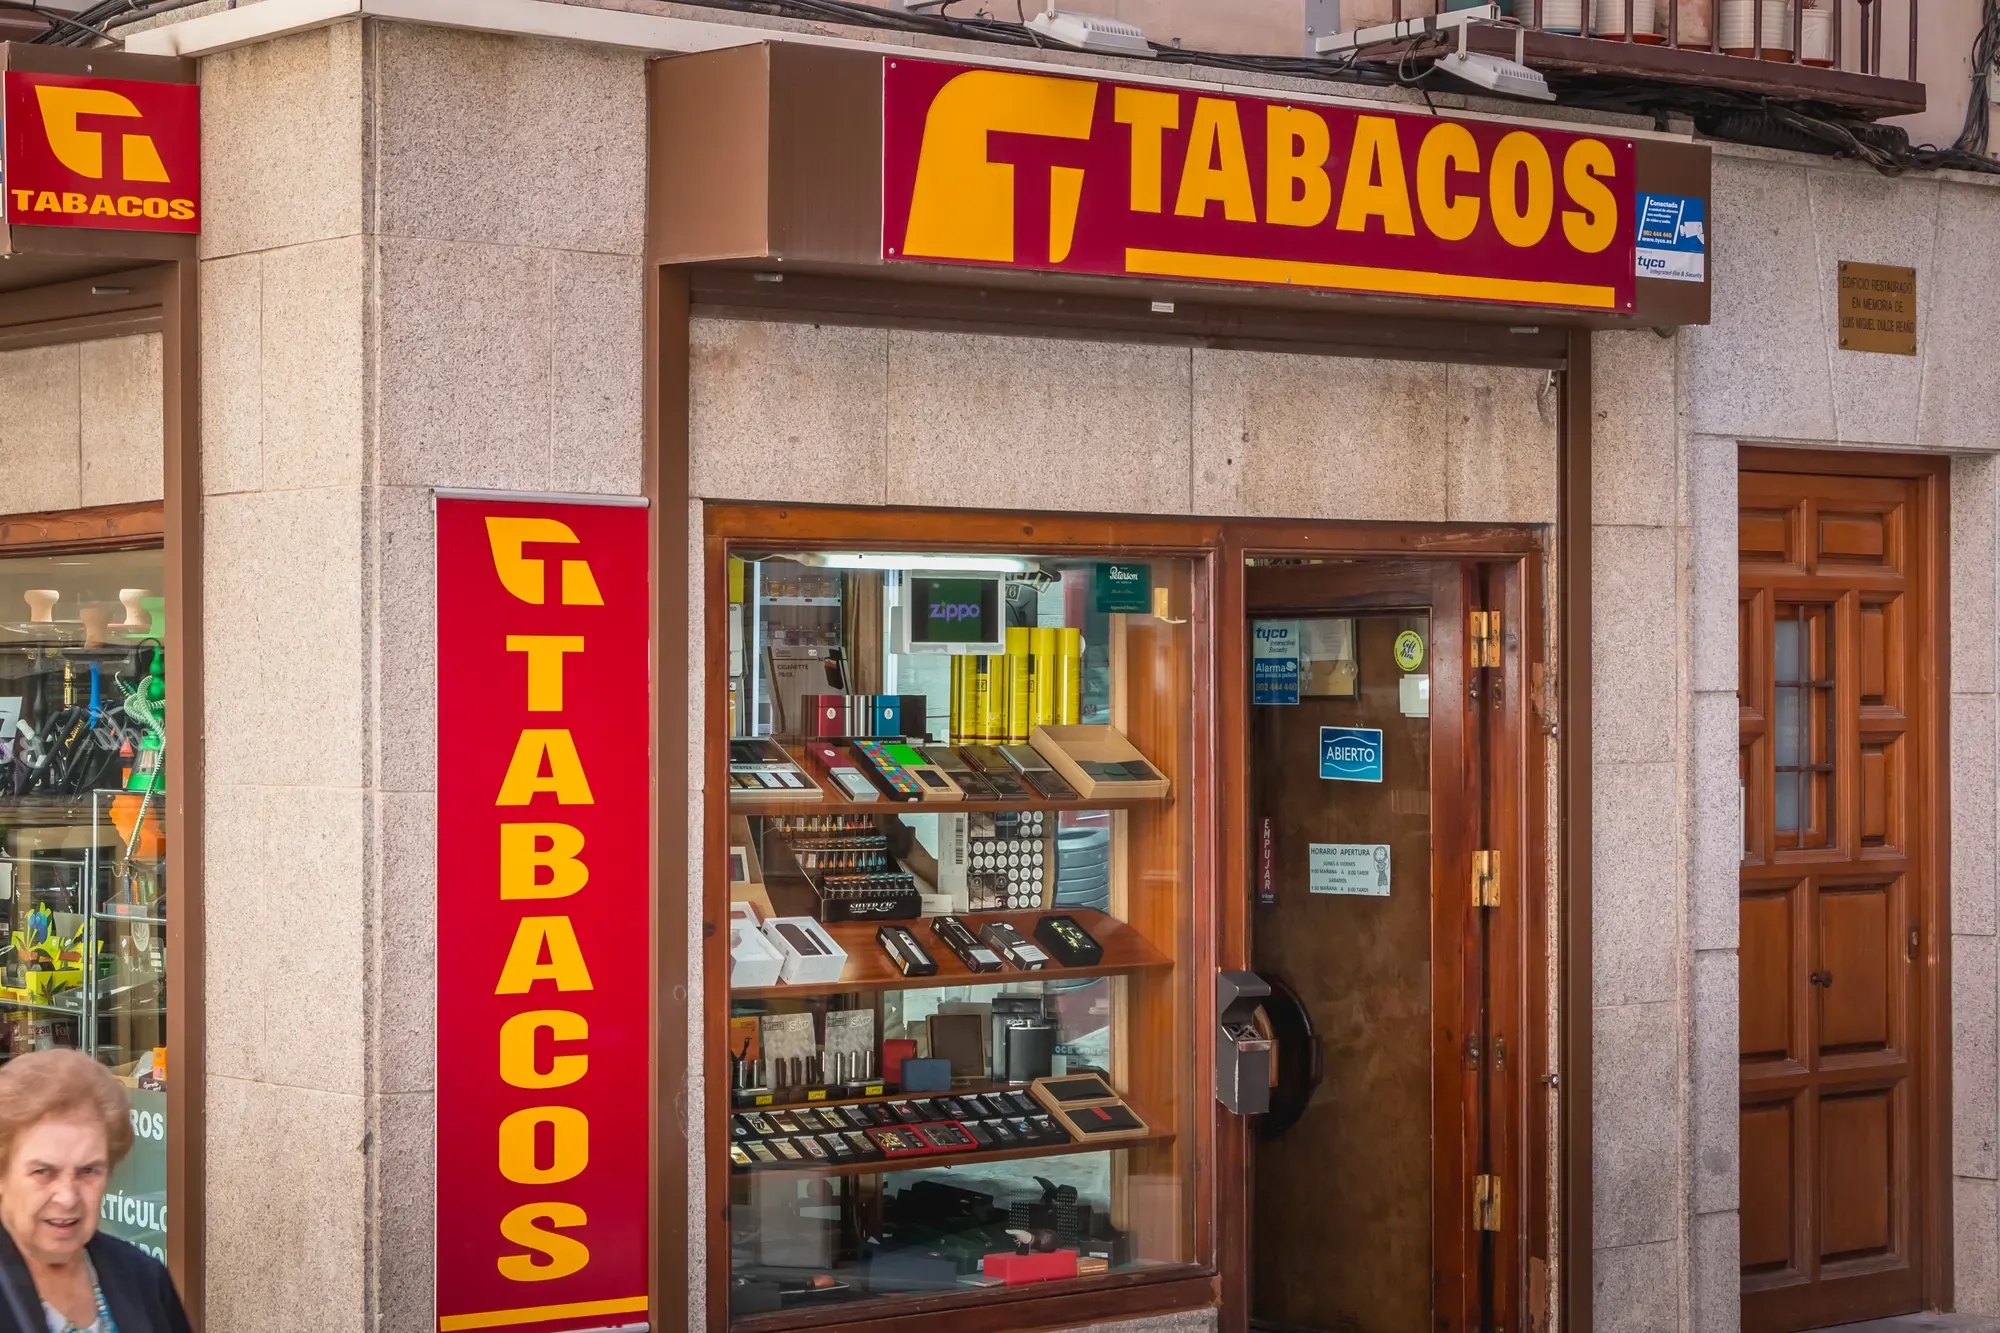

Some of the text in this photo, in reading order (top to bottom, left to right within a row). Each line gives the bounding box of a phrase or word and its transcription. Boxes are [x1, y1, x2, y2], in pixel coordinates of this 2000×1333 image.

[1114, 87, 1617, 254] TABACOS
[12, 189, 195, 220] TABACOS
[1649, 200, 1678, 209] Conectada
[1637, 255, 1666, 270] tyco
[1649, 268, 1672, 276] Integrated
[1685, 271, 1702, 279] Security
[1842, 276, 1913, 294] EDIFICIO RESTAURADO
[1852, 297, 1904, 313] EN MEMORIA DE
[1842, 316, 1855, 328] LUIS
[1855, 317, 1876, 331] MIGUEL
[1877, 319, 1894, 333] DULCE
[1109, 566, 1138, 580] Peterson
[930, 600, 980, 622] zippo
[1256, 627, 1288, 642] tyco
[1256, 663, 1286, 672] Alarma
[1256, 683, 1269, 691] 902
[1284, 683, 1297, 691] 440
[1326, 746, 1375, 763] ABIERTO
[1310, 847, 1337, 855] HORARIO
[850, 901, 878, 911] SILVER
[494, 635, 595, 1282] TABACOS
[789, 1020, 809, 1031] Silver
[850, 1016, 871, 1028] Silver
